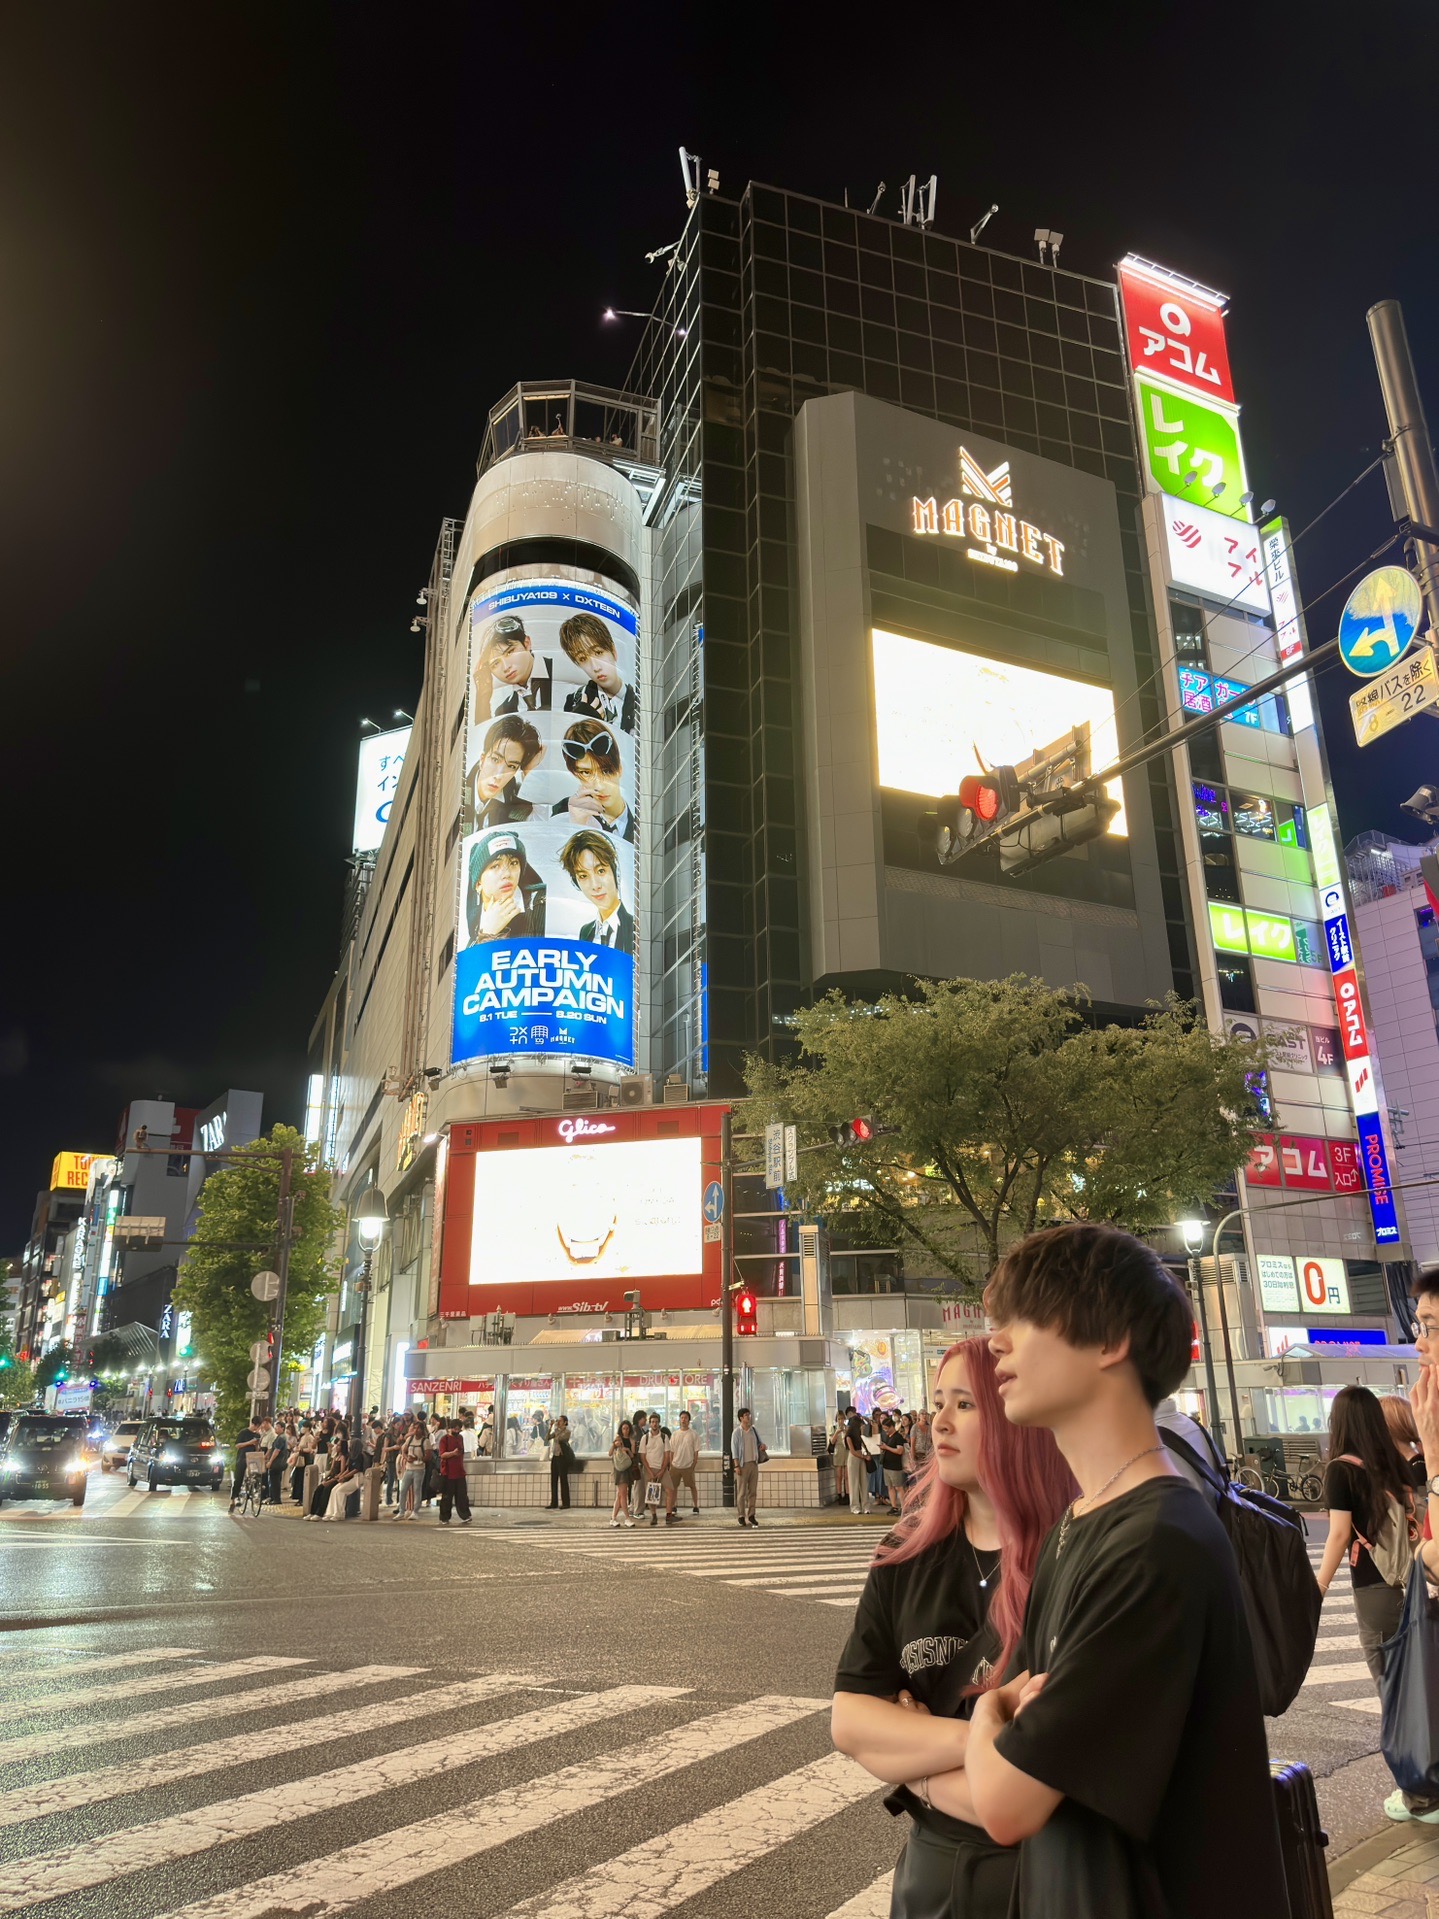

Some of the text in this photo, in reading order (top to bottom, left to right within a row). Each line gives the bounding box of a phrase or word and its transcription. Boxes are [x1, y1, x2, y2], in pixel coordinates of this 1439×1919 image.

[1138, 325, 1222, 386] アコム
[911, 495, 1066, 577] MAGNET
[488, 591, 558, 611] SHIBUYA109
[574, 594, 621, 619] DXTEEN
[1222, 913, 1293, 949] レイク
[491, 948, 599, 972] EARLY
[474, 968, 614, 996] AUTUMN
[462, 987, 625, 1020] CAMPAIGN
[494, 1010, 518, 1020] TUE
[583, 1014, 607, 1025] SUN
[1342, 1000, 1364, 1047] アコム
[1316, 1046, 1334, 1066] 4F
[557, 1118, 616, 1143] Glico
[773, 1128, 782, 1182] 渋谷駅前
[1253, 1145, 1328, 1178] アコム
[1334, 1146, 1352, 1163] 3F
[1334, 1171, 1352, 1188] 入口
[1364, 1133, 1389, 1206] PROMISE
[160, 1304, 173, 1339] ZARA
[942, 1303, 986, 1323] MAGN
[410, 1381, 462, 1393] SANZENRI
